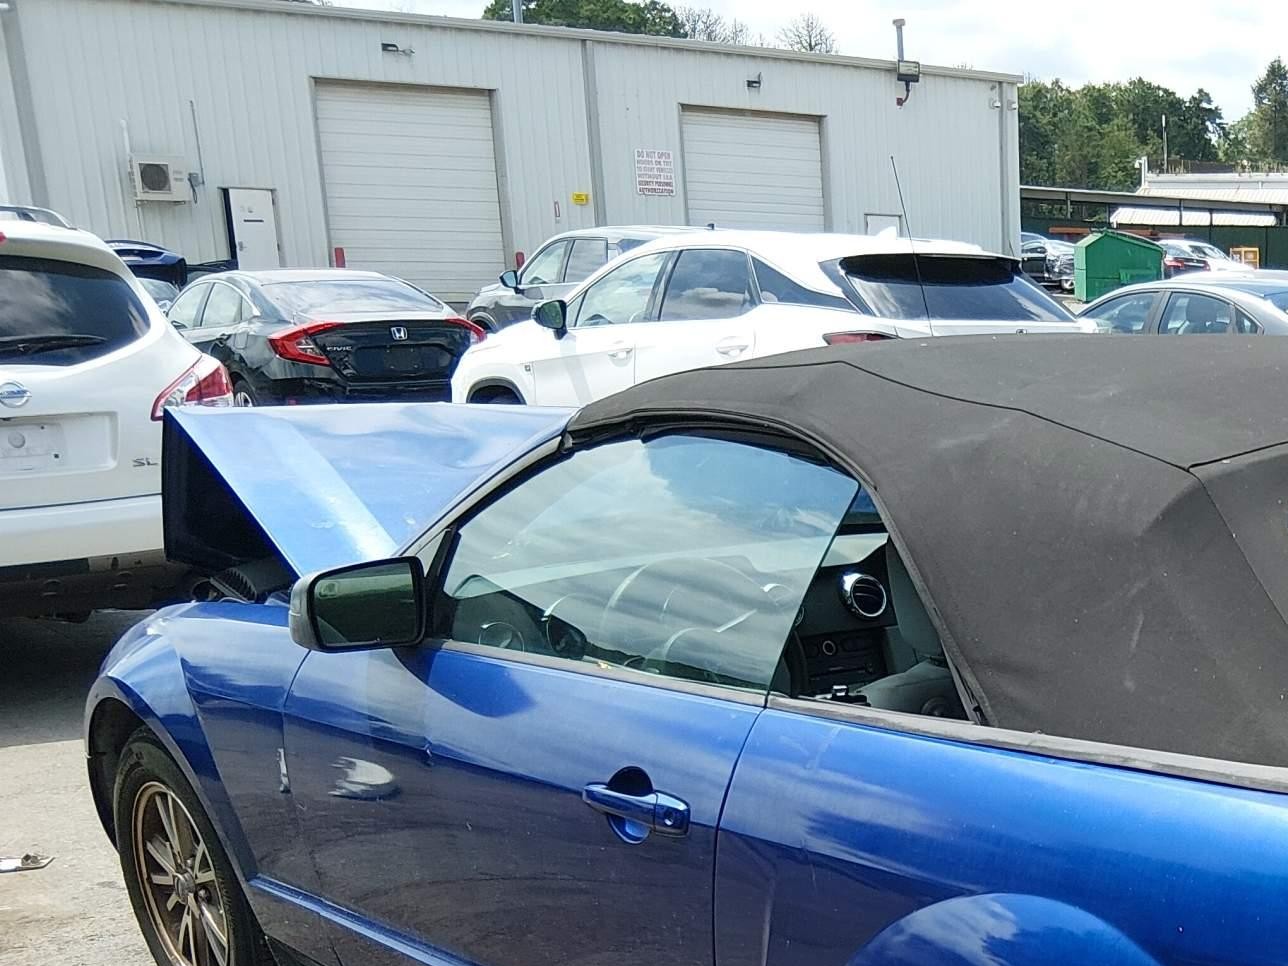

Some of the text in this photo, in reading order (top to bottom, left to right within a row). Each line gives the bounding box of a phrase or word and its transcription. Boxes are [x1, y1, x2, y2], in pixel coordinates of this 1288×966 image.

[637, 150, 671, 160] DO NOT OPEN
[132, 457, 160, 468] SL
